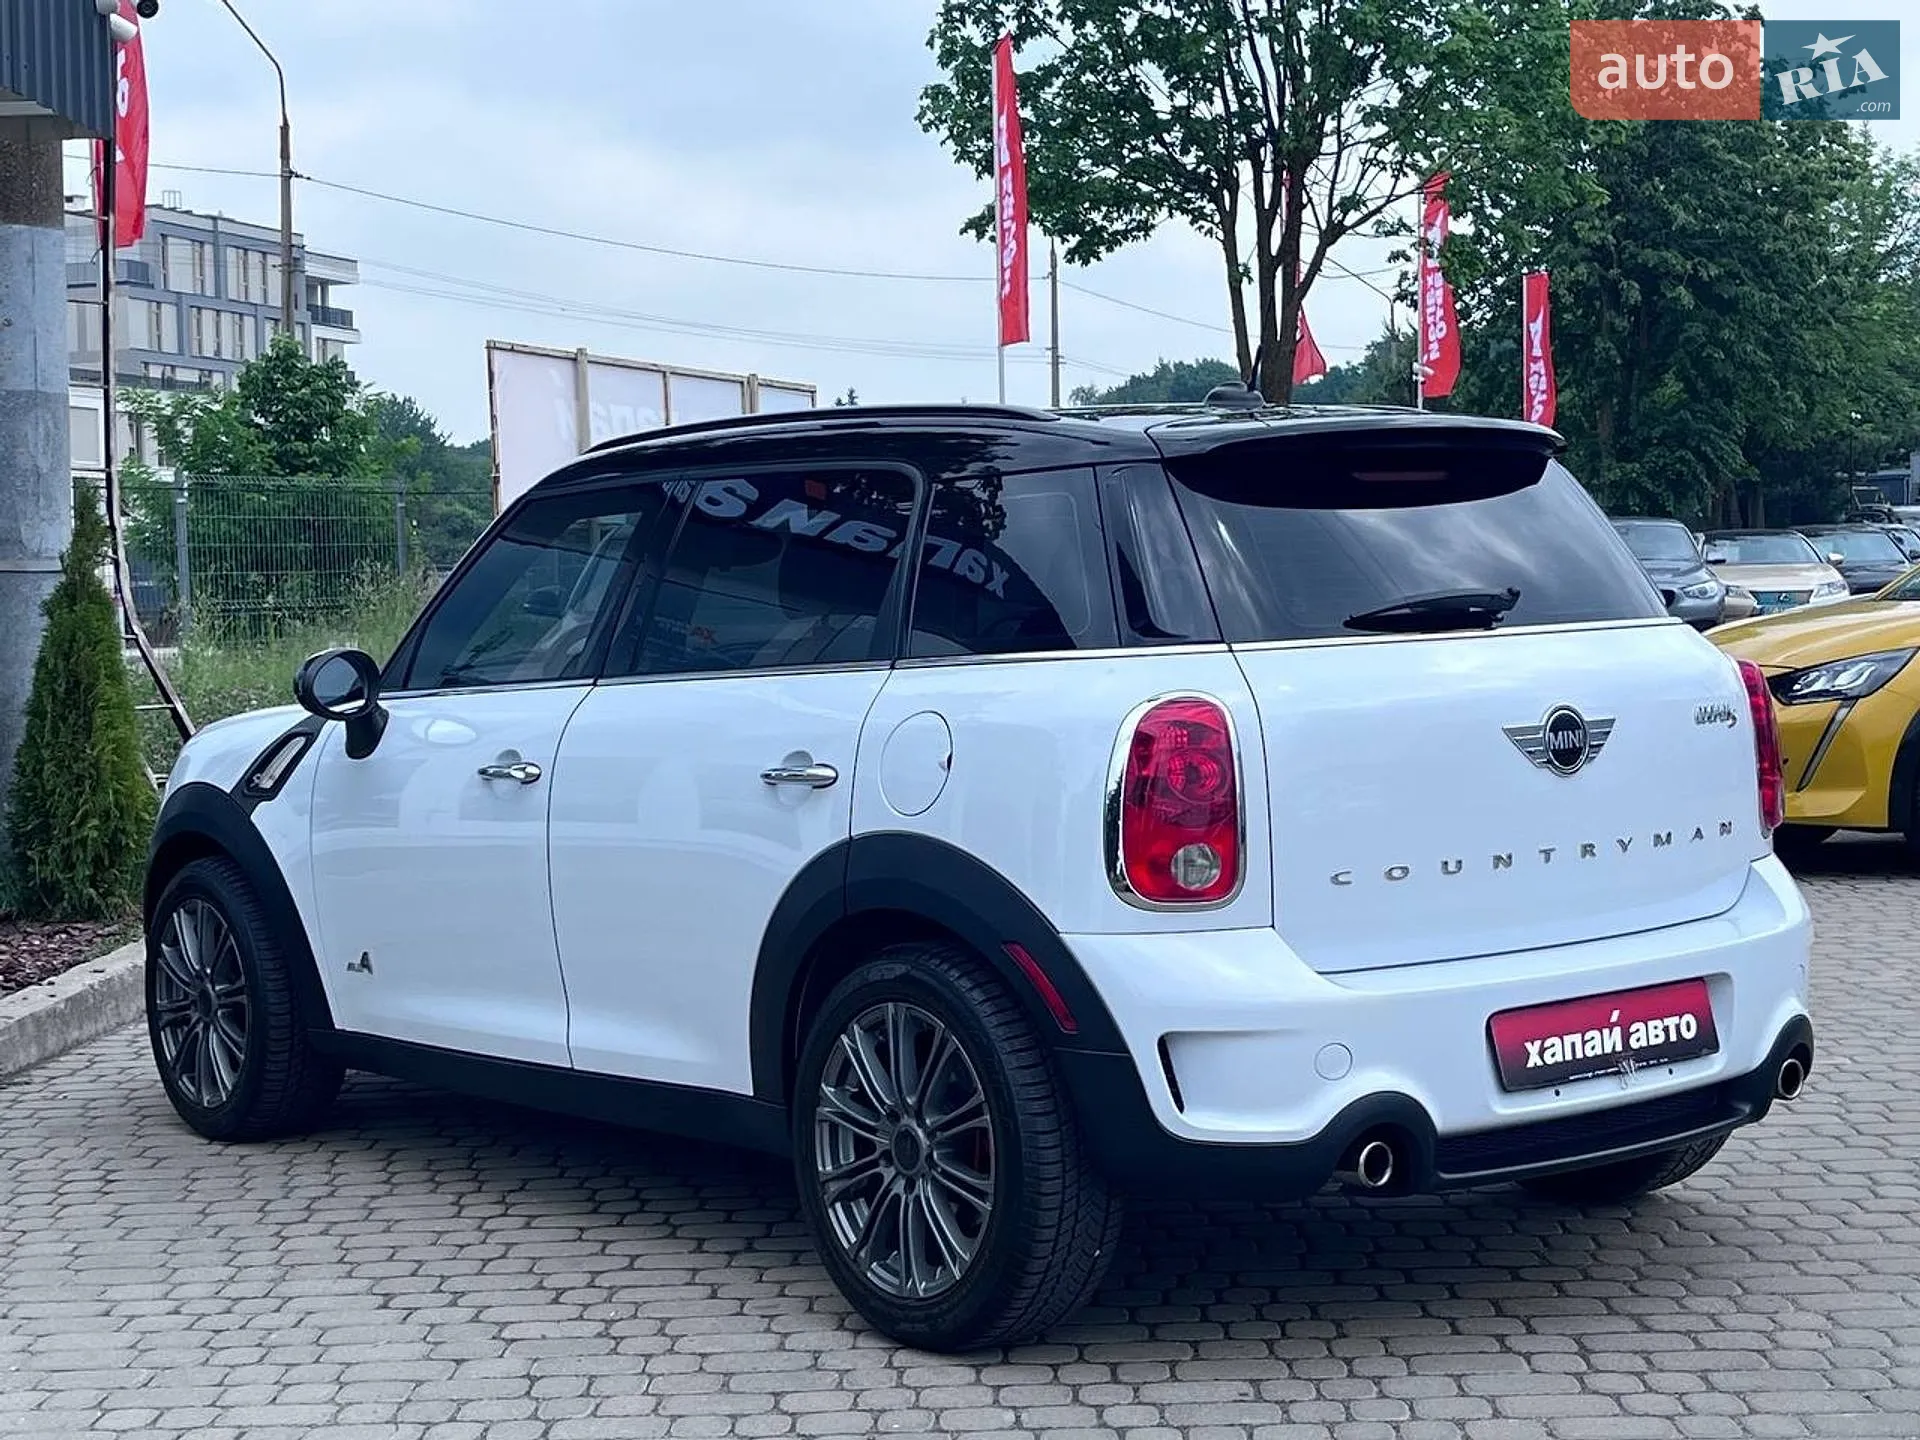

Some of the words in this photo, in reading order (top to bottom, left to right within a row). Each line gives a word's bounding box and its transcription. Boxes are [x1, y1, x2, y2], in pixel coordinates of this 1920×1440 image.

[1547, 730, 1584, 751] MINI
[1329, 820, 1733, 887] COUNTRYMAN
[1628, 1012, 1698, 1051] авто
